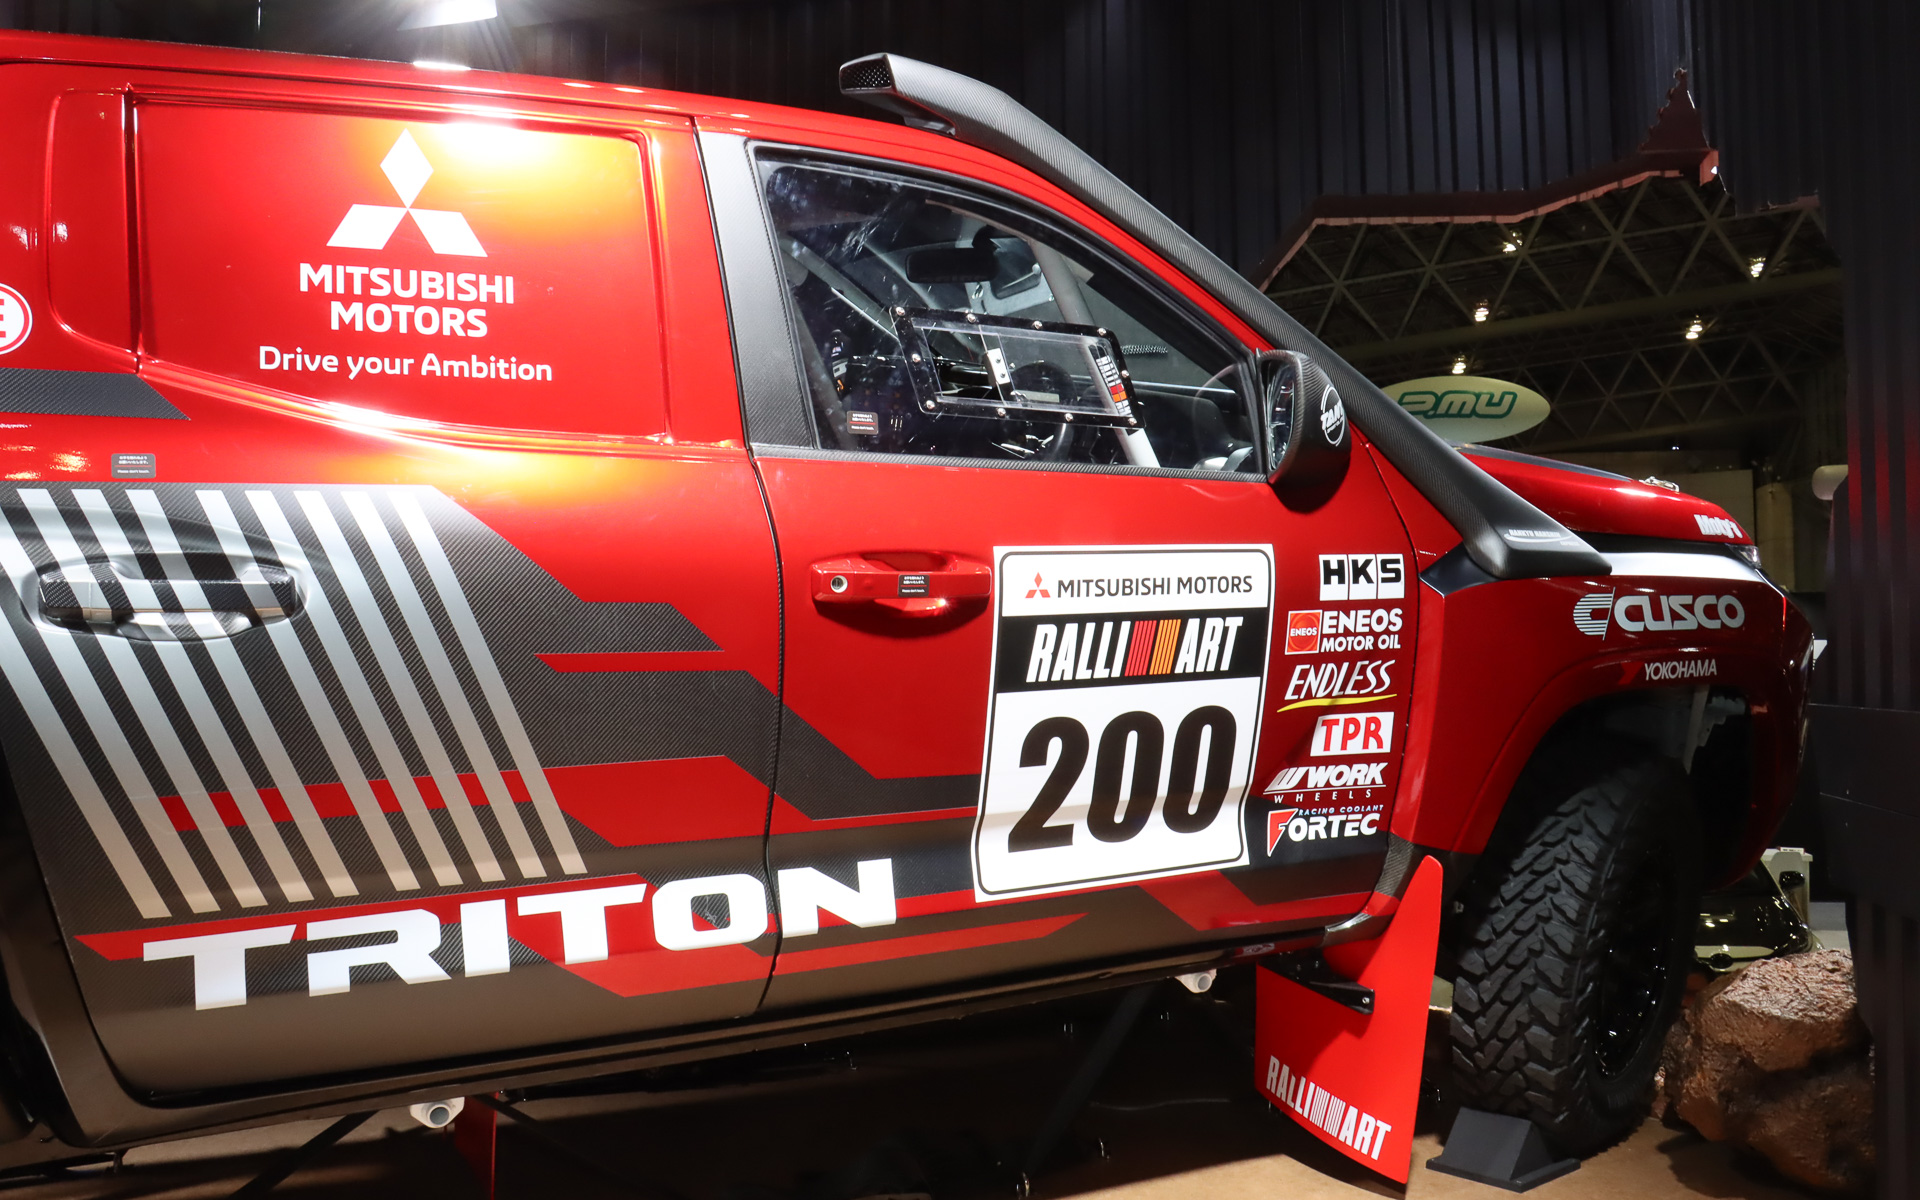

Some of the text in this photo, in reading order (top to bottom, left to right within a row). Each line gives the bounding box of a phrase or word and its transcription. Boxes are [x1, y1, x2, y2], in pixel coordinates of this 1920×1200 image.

[299, 262, 514, 304] MITSUBISHI
[330, 300, 488, 338] MOTORS
[259, 345, 553, 382] Drive your Ambition
[1057, 575, 1254, 599] MITSUBISHI MOTORS
[1322, 558, 1402, 585] HKS
[1321, 607, 1403, 634] ENEOS
[1613, 594, 1746, 632] CUSCO
[1290, 626, 1318, 637] ENEOS
[1320, 634, 1401, 653] MOTOR OIL
[1284, 659, 1396, 700] ENDLESS
[1644, 658, 1718, 681] YOKOHAMA
[1320, 715, 1384, 752] TPR
[1007, 704, 1238, 854] 200
[1306, 762, 1389, 789] WORK
[1273, 789, 1373, 804] WHEELS
[1298, 804, 1384, 816] RACING COOLANT
[1267, 807, 1381, 858] FORTEC
[143, 857, 897, 1011] TRITON
